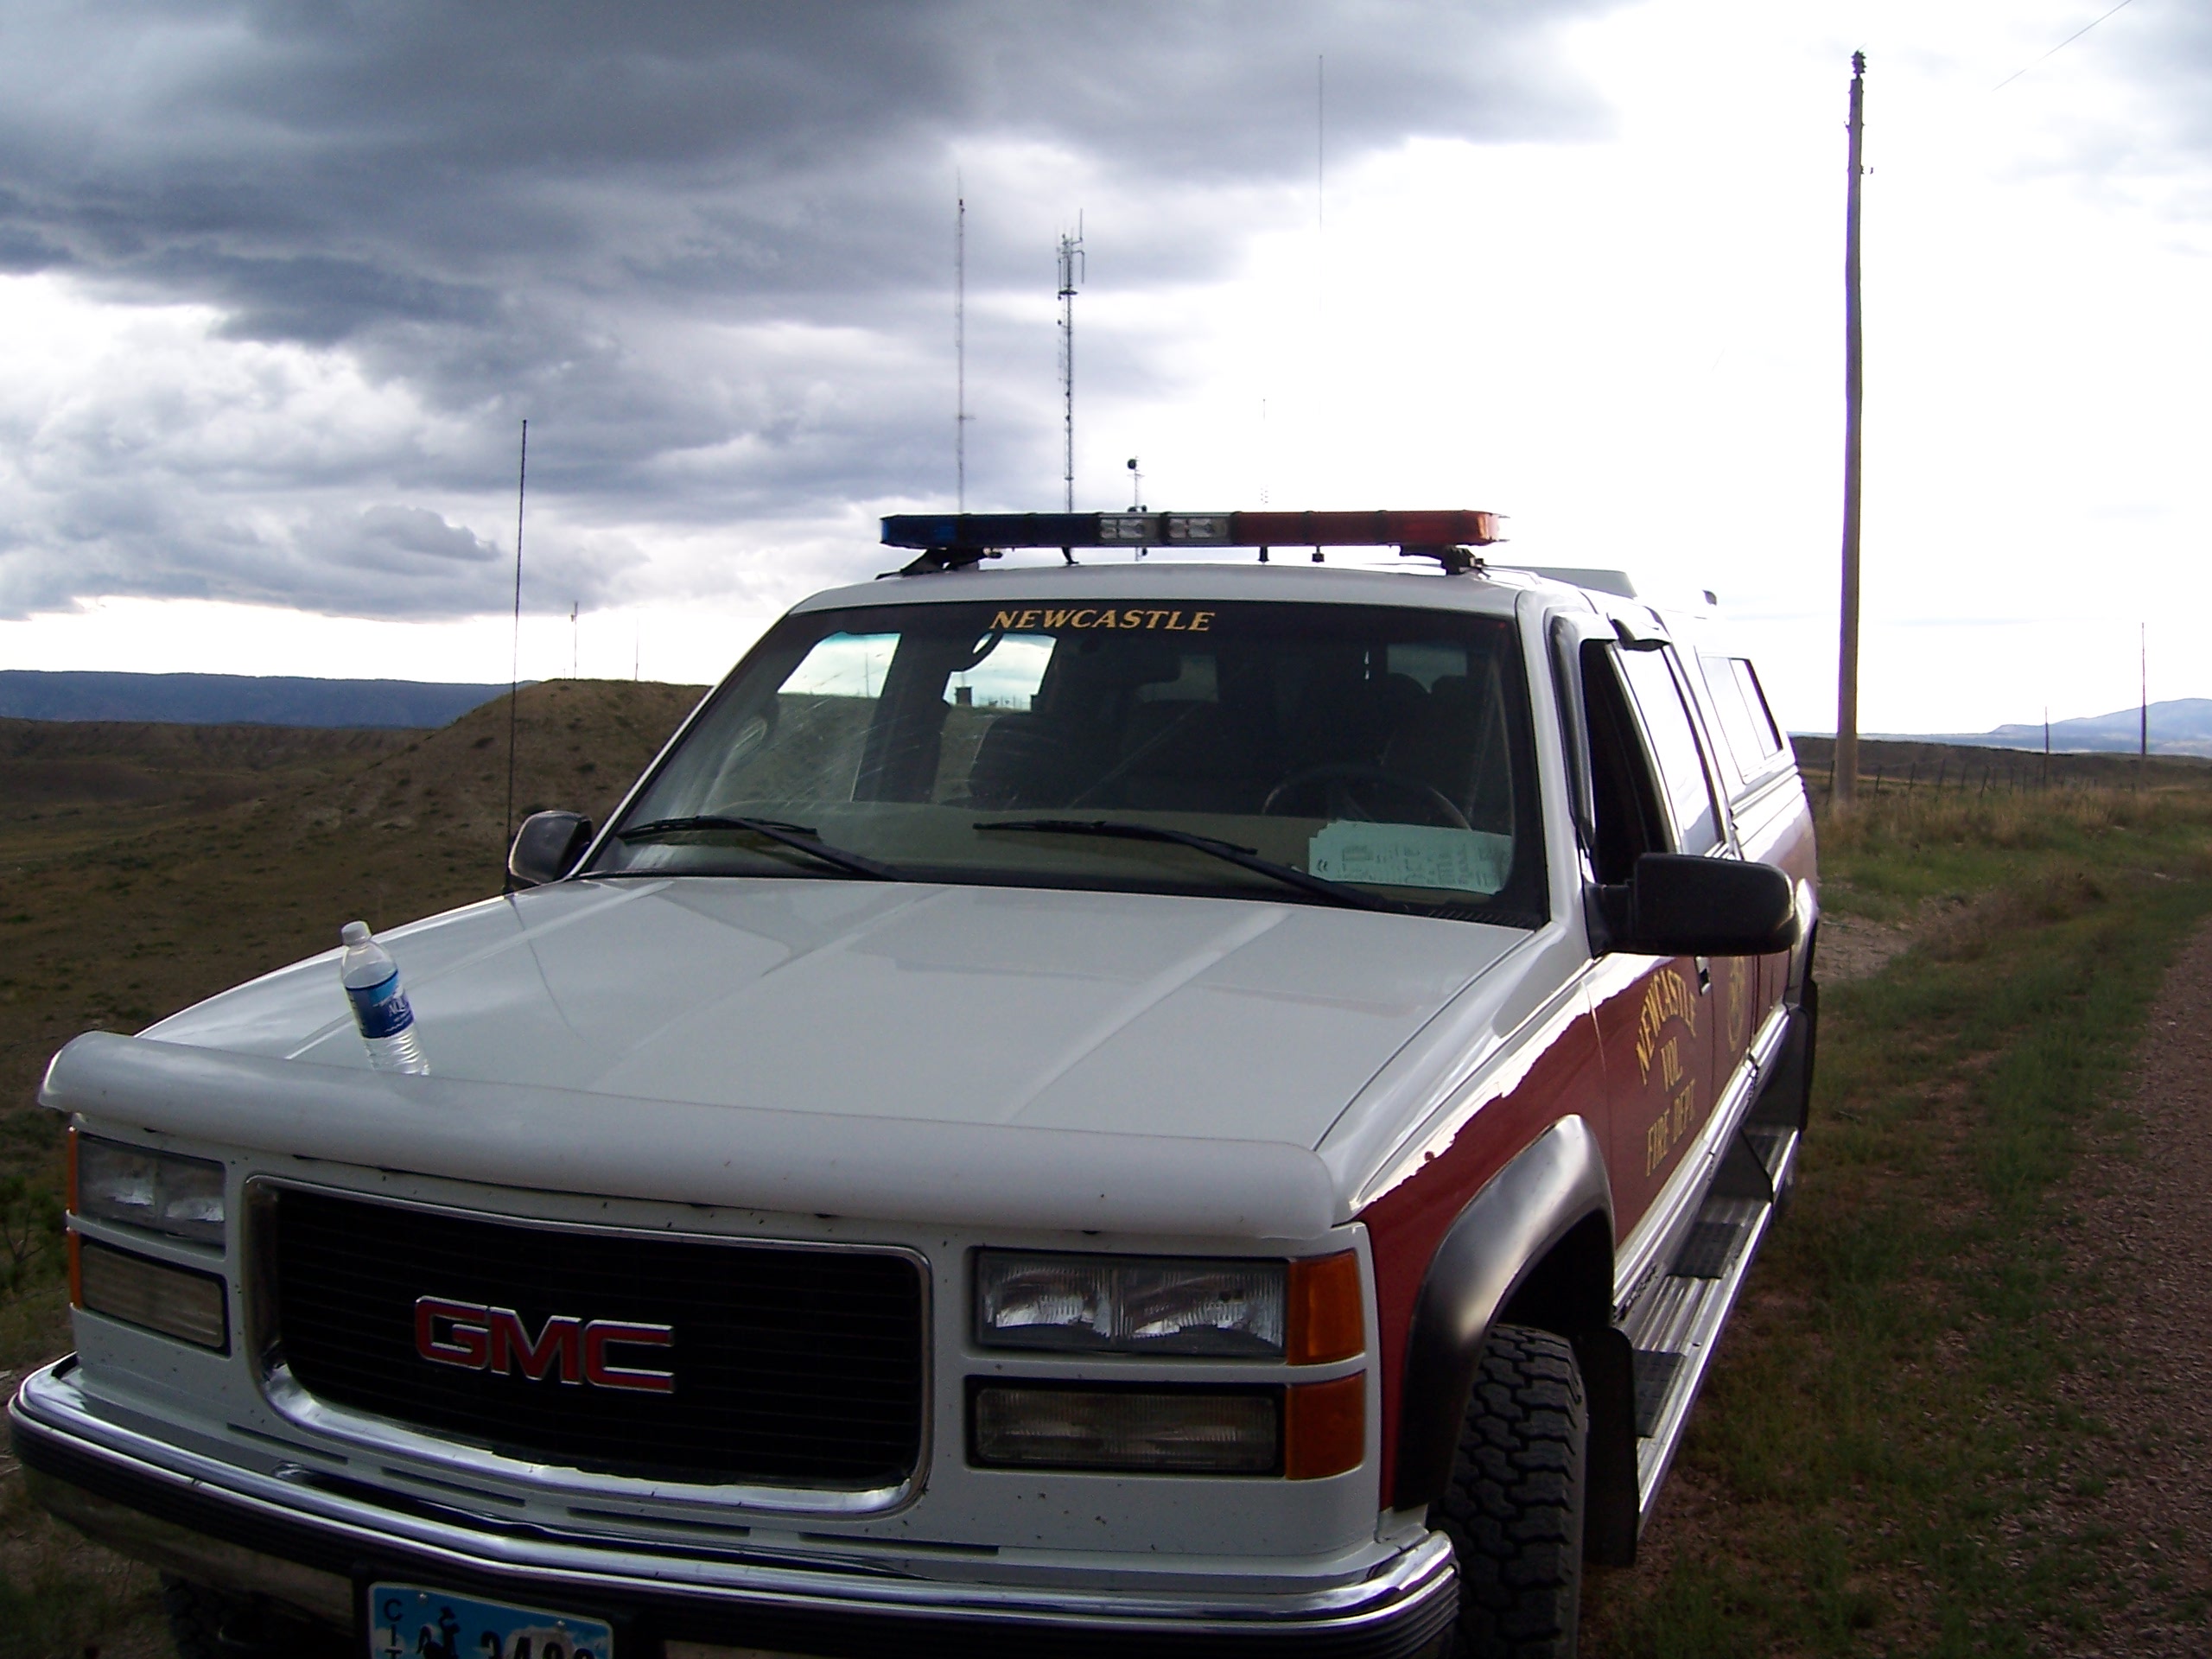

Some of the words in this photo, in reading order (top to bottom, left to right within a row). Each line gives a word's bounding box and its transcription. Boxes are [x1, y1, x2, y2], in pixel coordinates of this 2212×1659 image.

[988, 608, 1216, 632] NEWCASTLE
[1645, 1107, 1669, 1177] FIRE
[415, 1295, 675, 1394] GMC
